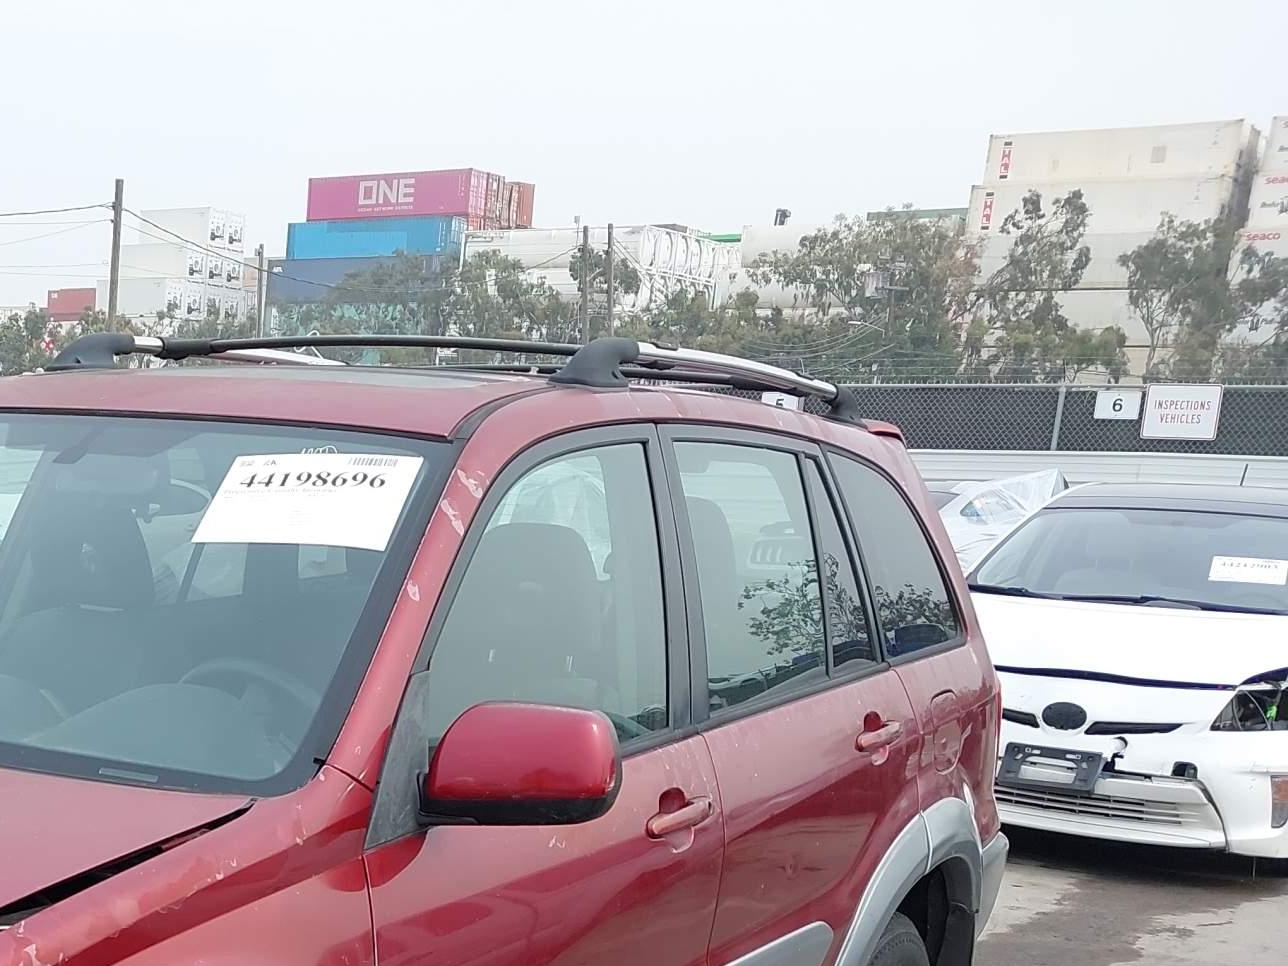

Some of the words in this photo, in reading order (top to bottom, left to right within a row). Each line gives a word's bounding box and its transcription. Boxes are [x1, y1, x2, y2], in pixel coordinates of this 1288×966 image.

[358, 178, 416, 205] ONE
[1246, 231, 1281, 241] seaco
[1112, 398, 1123, 413] 6
[1154, 399, 1211, 411] INSPECTIONS
[1159, 413, 1201, 424] VEHICLES
[239, 471, 389, 489] 44198696
